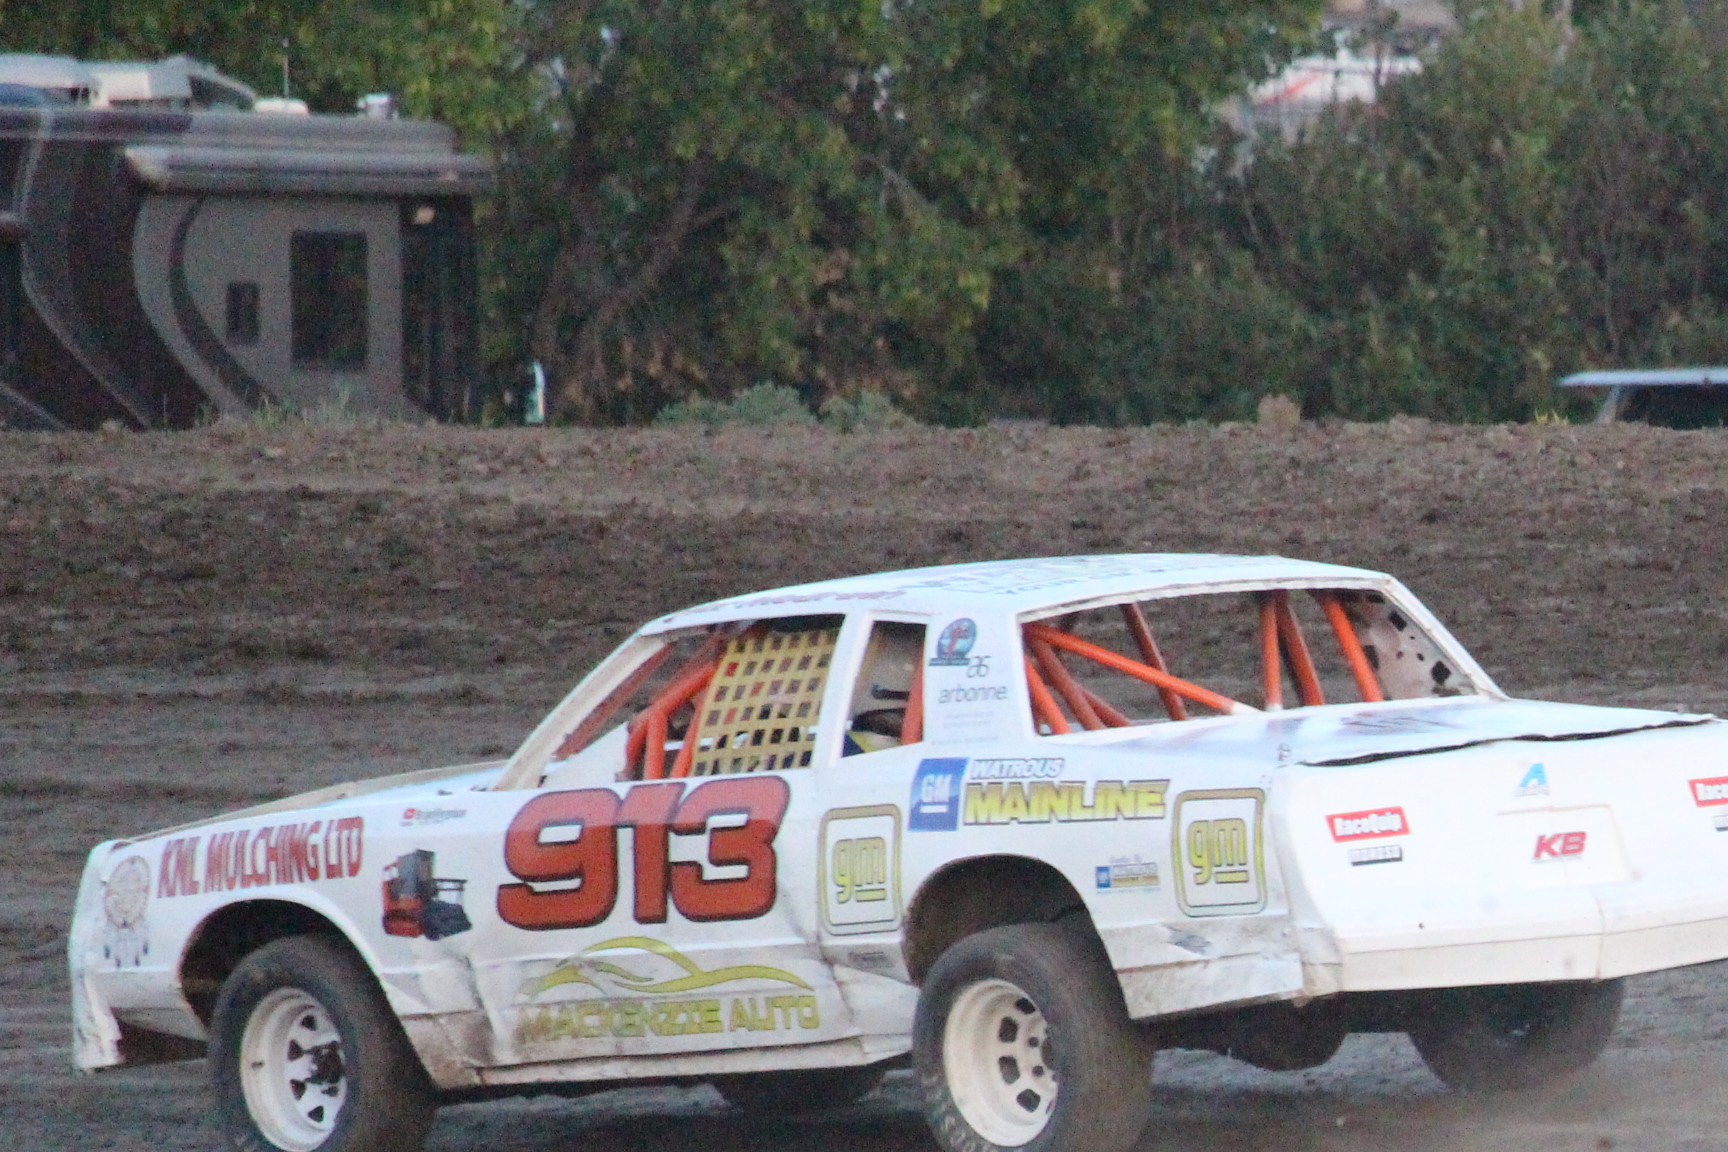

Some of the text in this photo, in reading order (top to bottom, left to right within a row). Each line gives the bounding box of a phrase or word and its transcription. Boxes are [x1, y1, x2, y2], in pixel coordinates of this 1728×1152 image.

[938, 683, 1008, 704] arbonne
[969, 758, 1065, 780] WATROUS
[963, 779, 1171, 826] MAINLINE
[1333, 811, 1404, 836] RaceQuip
[156, 816, 364, 899] KNL MULCHING LTD
[497, 775, 791, 931] 913
[1534, 830, 1588, 858] KB
[516, 995, 820, 1046] MACKENZIE AUTO
